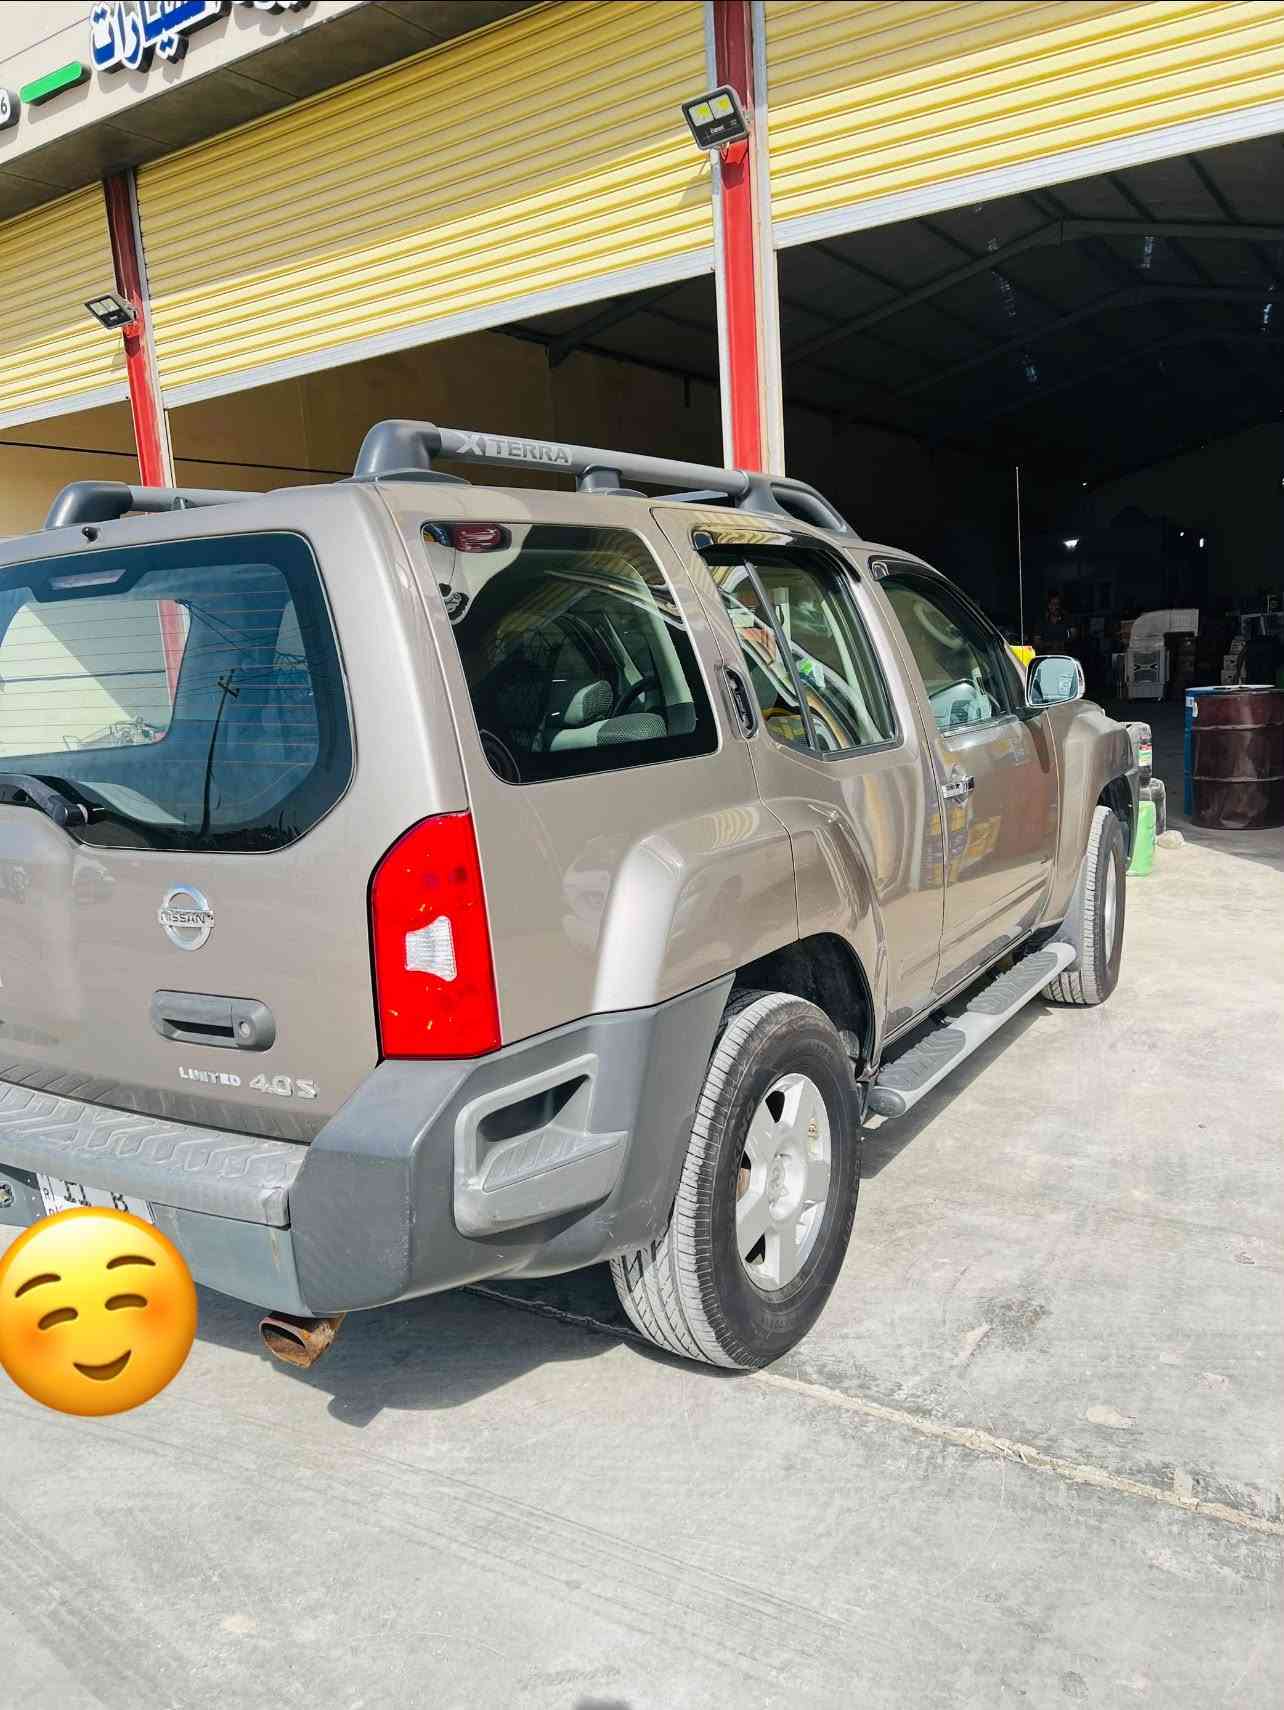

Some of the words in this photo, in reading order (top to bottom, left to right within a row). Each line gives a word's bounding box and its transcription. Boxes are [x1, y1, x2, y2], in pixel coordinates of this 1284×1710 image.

[456, 434, 571, 465] XTERRA
[160, 909, 207, 925] NISSAN
[178, 1066, 241, 1087] LIMITED
